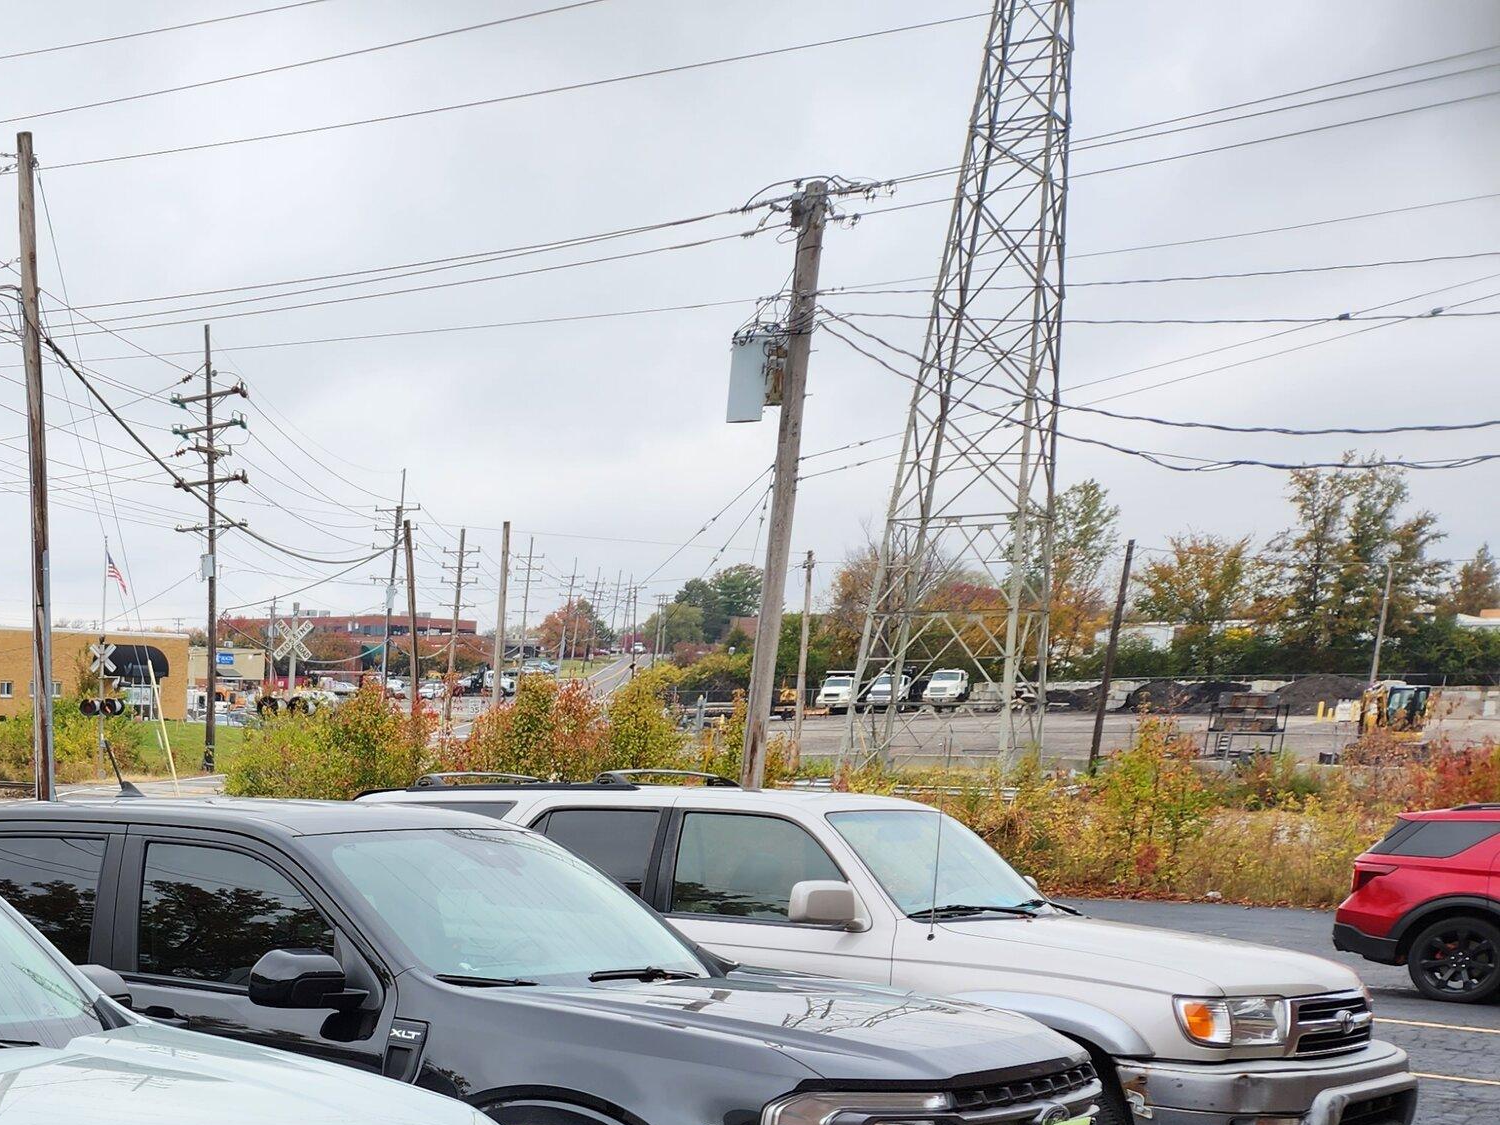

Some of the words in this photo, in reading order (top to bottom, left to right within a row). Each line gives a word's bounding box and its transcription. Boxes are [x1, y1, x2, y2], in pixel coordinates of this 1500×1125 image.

[276, 621, 290, 639] RAIL
[294, 643, 311, 659] ROAD
[390, 1028, 421, 1040] XLT
